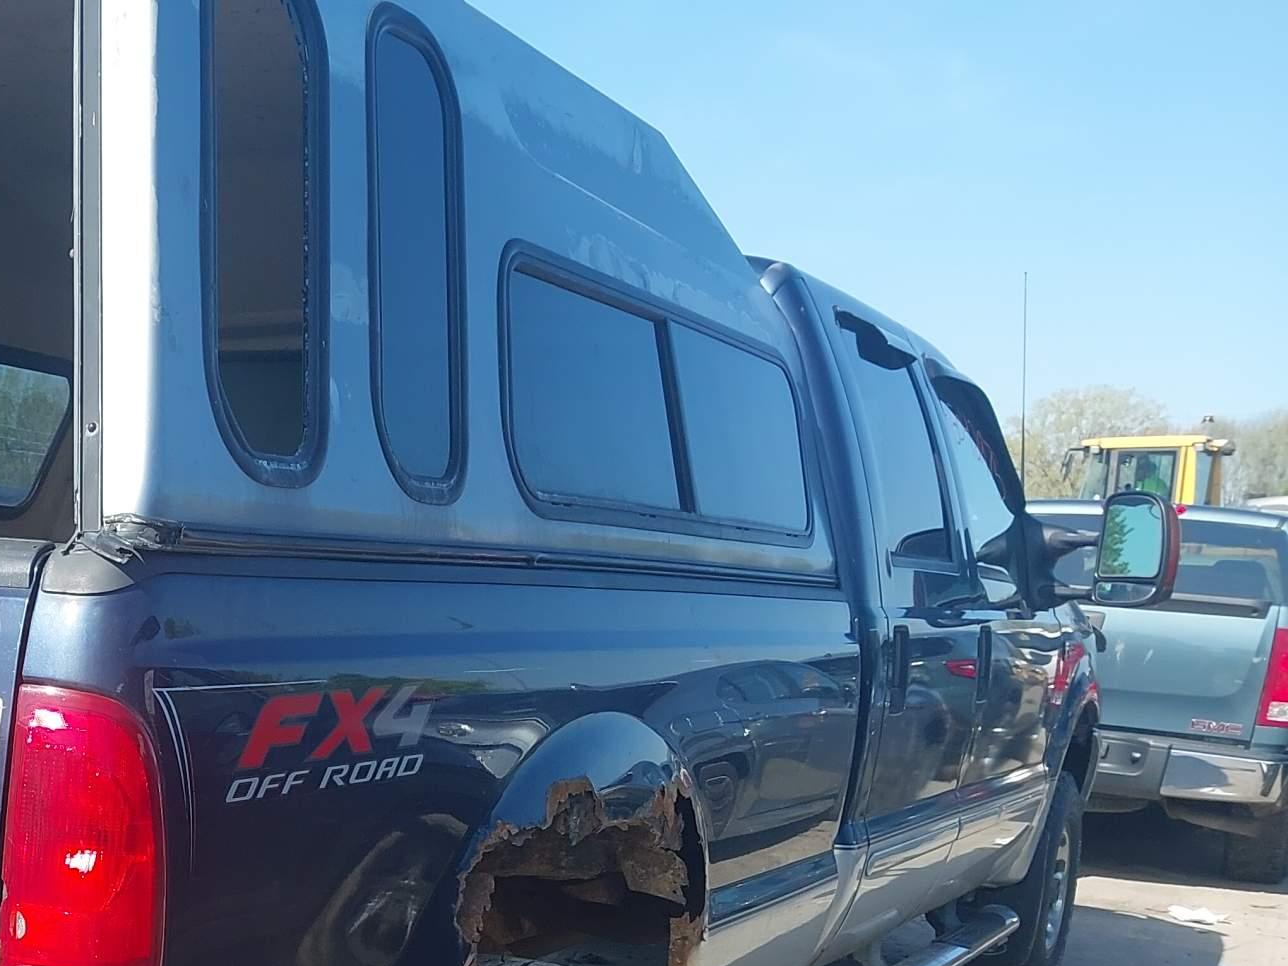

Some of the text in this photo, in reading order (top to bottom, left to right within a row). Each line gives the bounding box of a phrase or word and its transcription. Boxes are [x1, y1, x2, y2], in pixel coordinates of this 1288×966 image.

[237, 682, 432, 769] FX4
[1191, 717, 1243, 736] GMC
[225, 753, 425, 803] OFF ROAD
